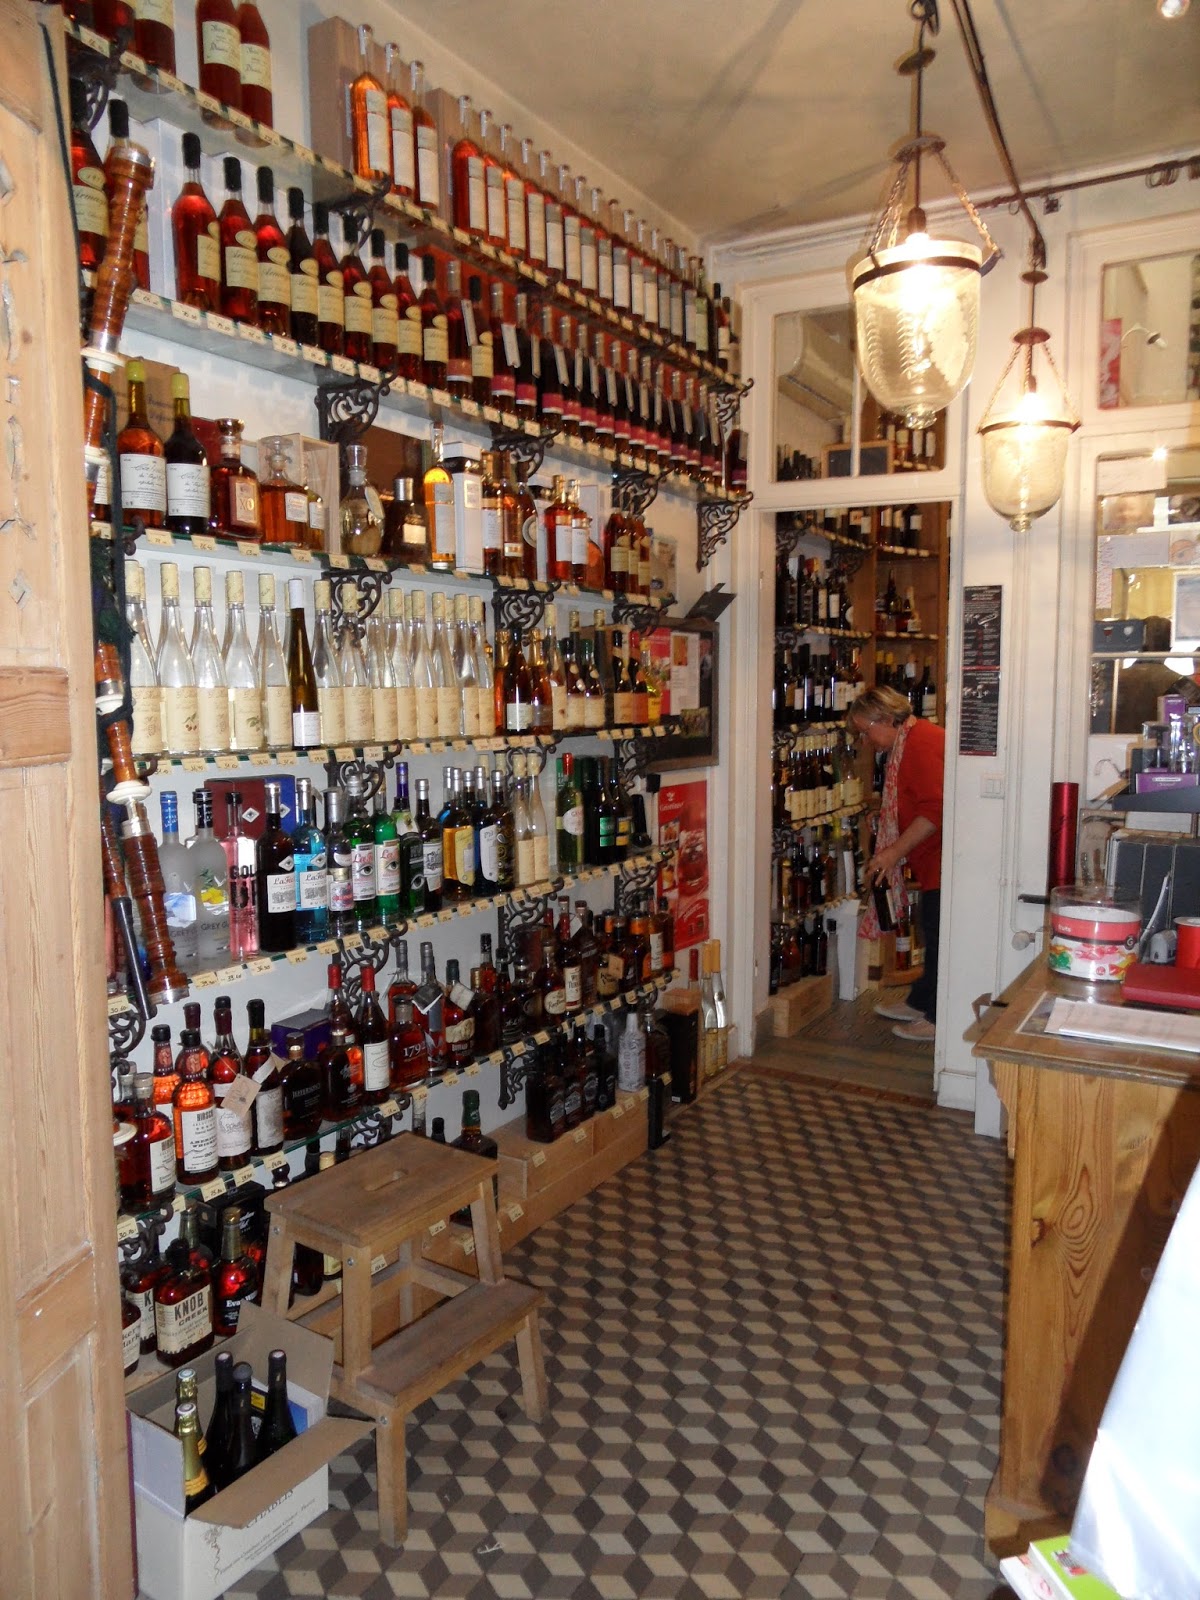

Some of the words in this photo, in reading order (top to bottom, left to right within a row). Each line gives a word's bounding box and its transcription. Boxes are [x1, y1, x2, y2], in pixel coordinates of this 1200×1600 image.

[174, 1291, 204, 1321] KNOB
[226, 1299, 241, 1308] Eva
[178, 1306, 208, 1326] CREEK
[122, 1331, 141, 1348] ark
